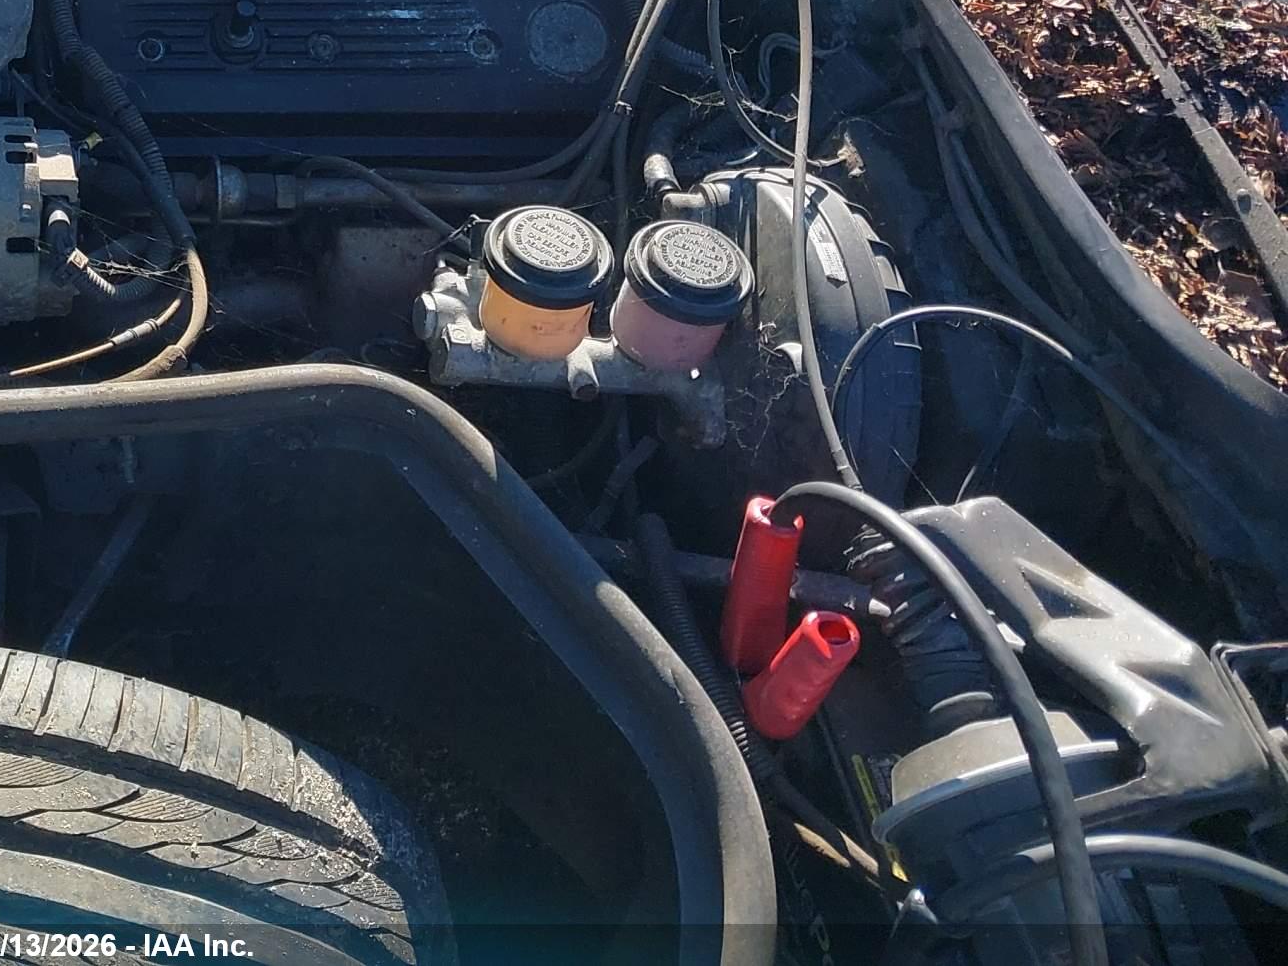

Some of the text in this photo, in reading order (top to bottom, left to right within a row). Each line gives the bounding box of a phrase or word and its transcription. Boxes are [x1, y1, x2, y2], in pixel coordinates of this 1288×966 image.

[527, 232, 570, 257] CAP BEFORE
[531, 222, 580, 250] CLEAN FILLER
[673, 241, 723, 262] CLEAN FILLER
[673, 251, 718, 272] CAP BEFORE
